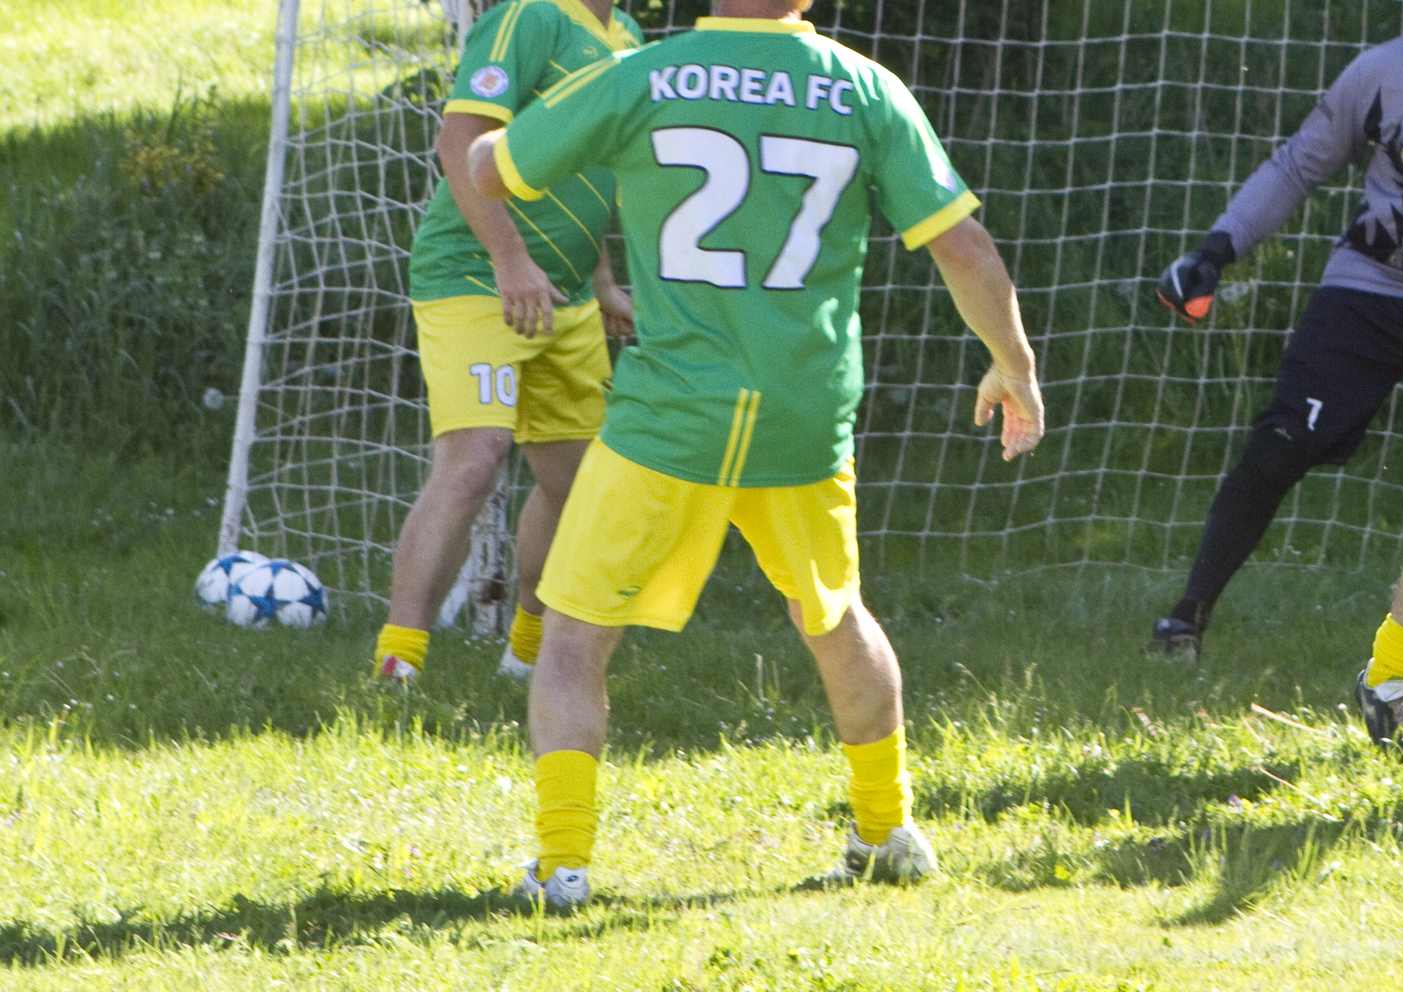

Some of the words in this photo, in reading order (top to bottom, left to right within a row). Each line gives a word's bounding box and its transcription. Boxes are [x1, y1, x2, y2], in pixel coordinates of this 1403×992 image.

[650, 64, 796, 106] KOREA
[806, 74, 854, 115] FC
[651, 125, 860, 290] 27
[469, 363, 517, 407] 10
[1306, 397, 1323, 431] 7
